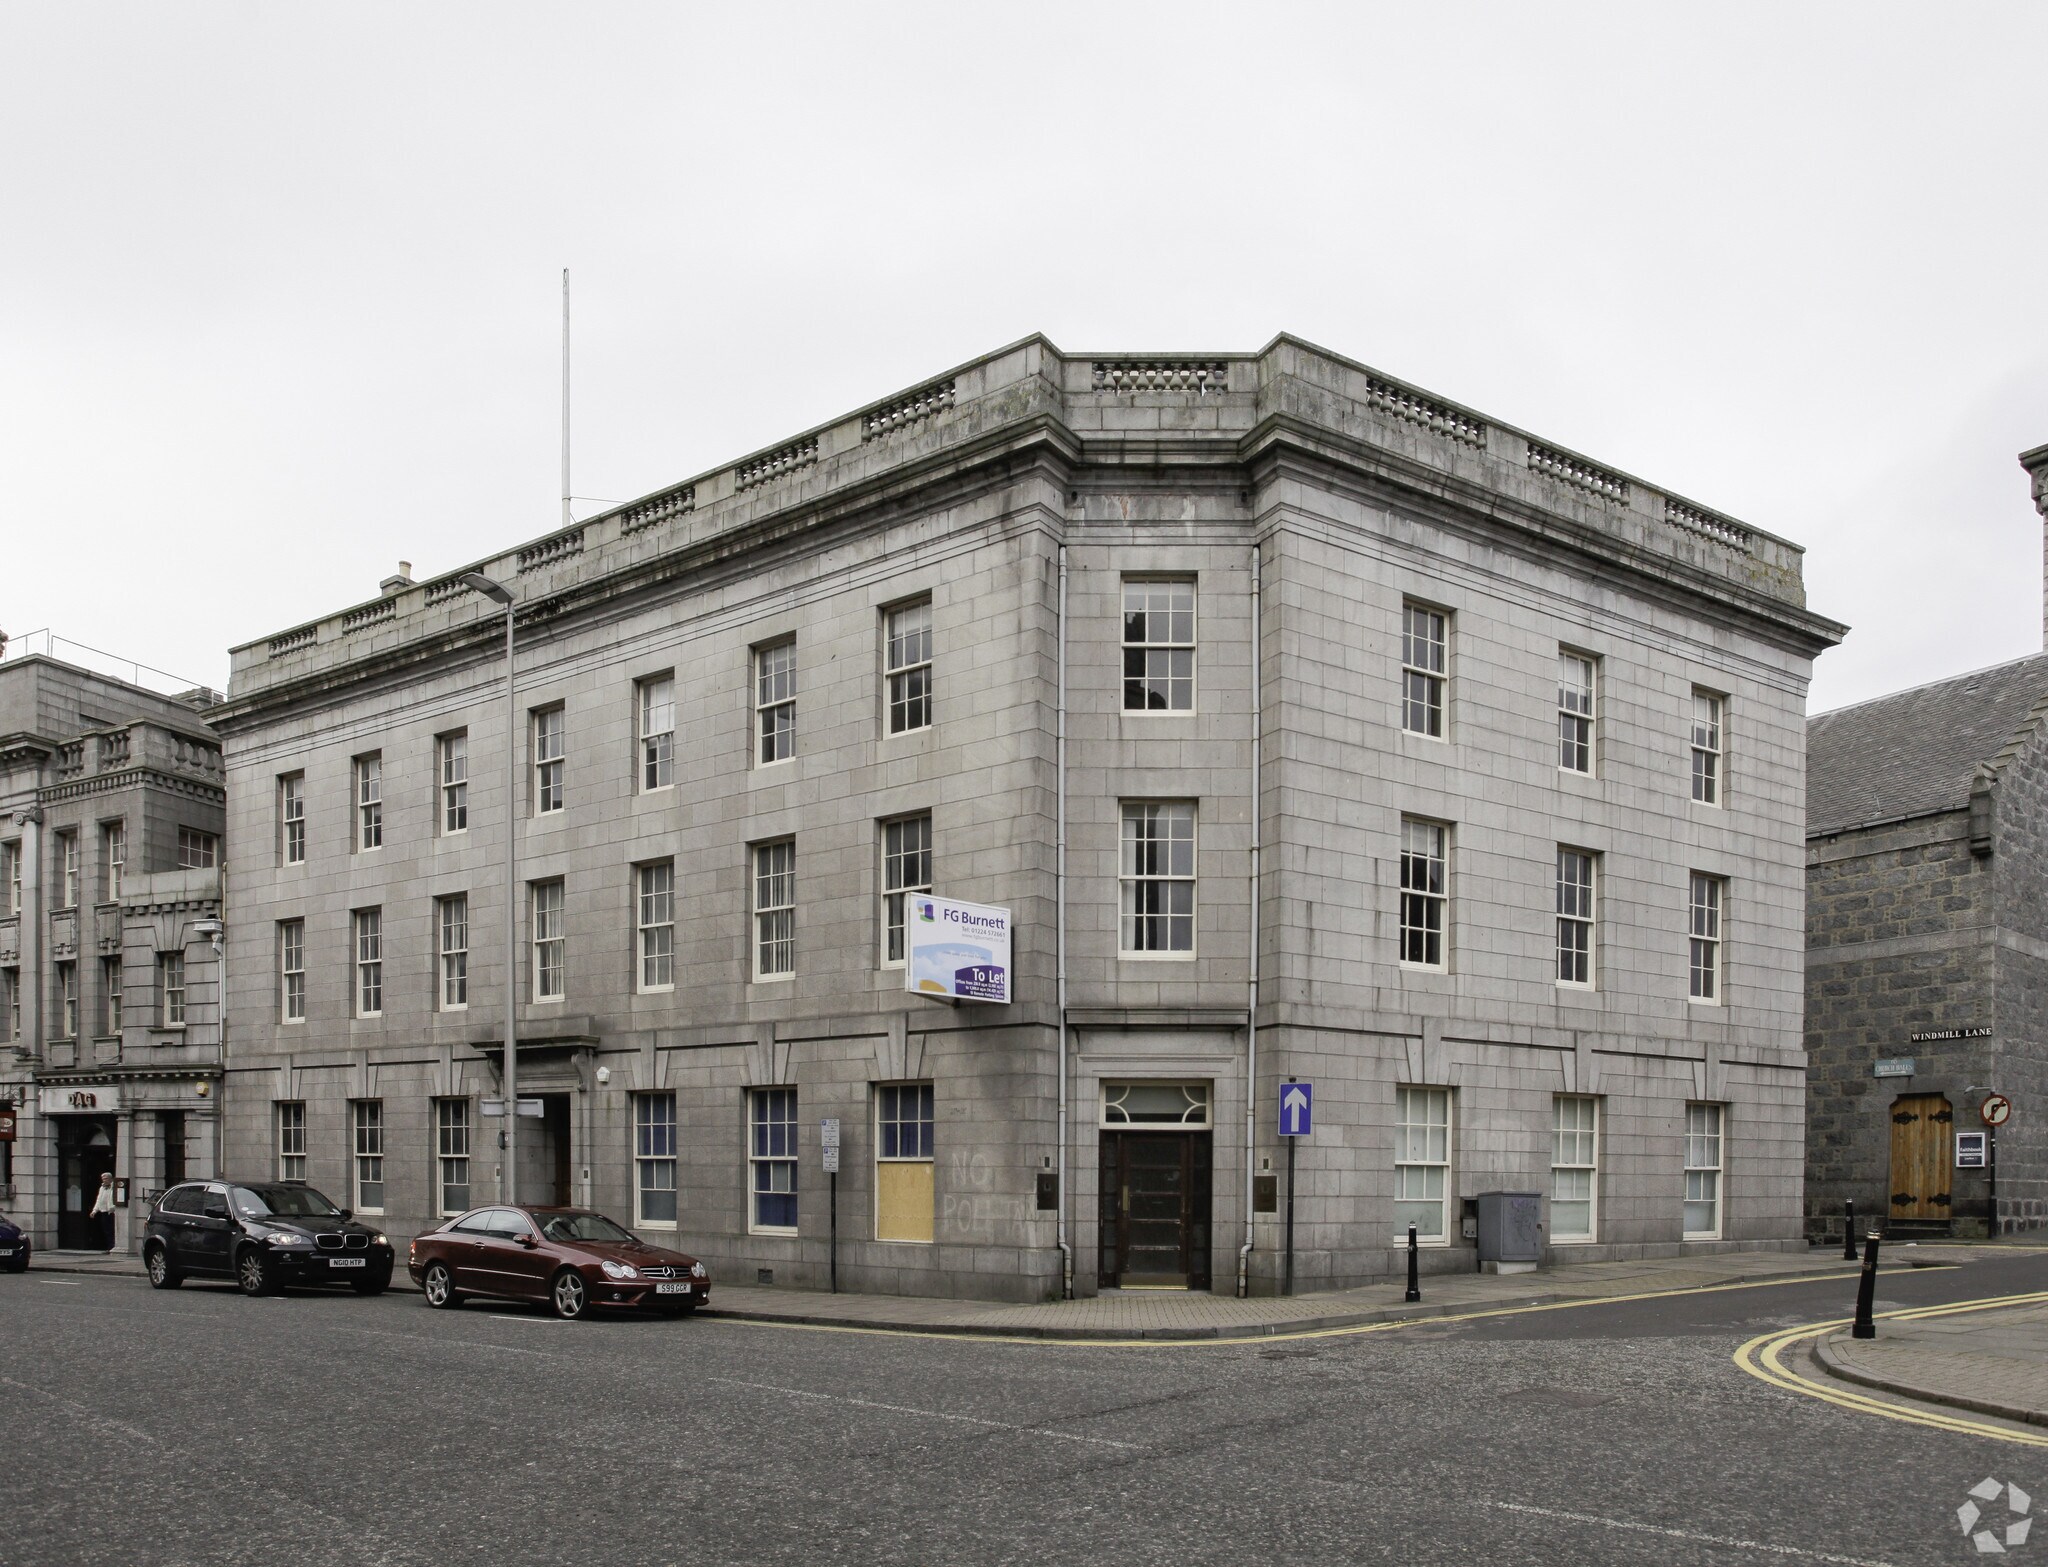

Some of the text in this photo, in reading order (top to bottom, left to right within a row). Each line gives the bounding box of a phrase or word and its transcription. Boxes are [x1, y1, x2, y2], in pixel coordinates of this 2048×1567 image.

[944, 908, 1005, 930] FG Burnett
[972, 968, 1004, 984] To Let
[1912, 1027, 1992, 1041] WINDMILL LANE
[952, 1151, 988, 1186] NO
